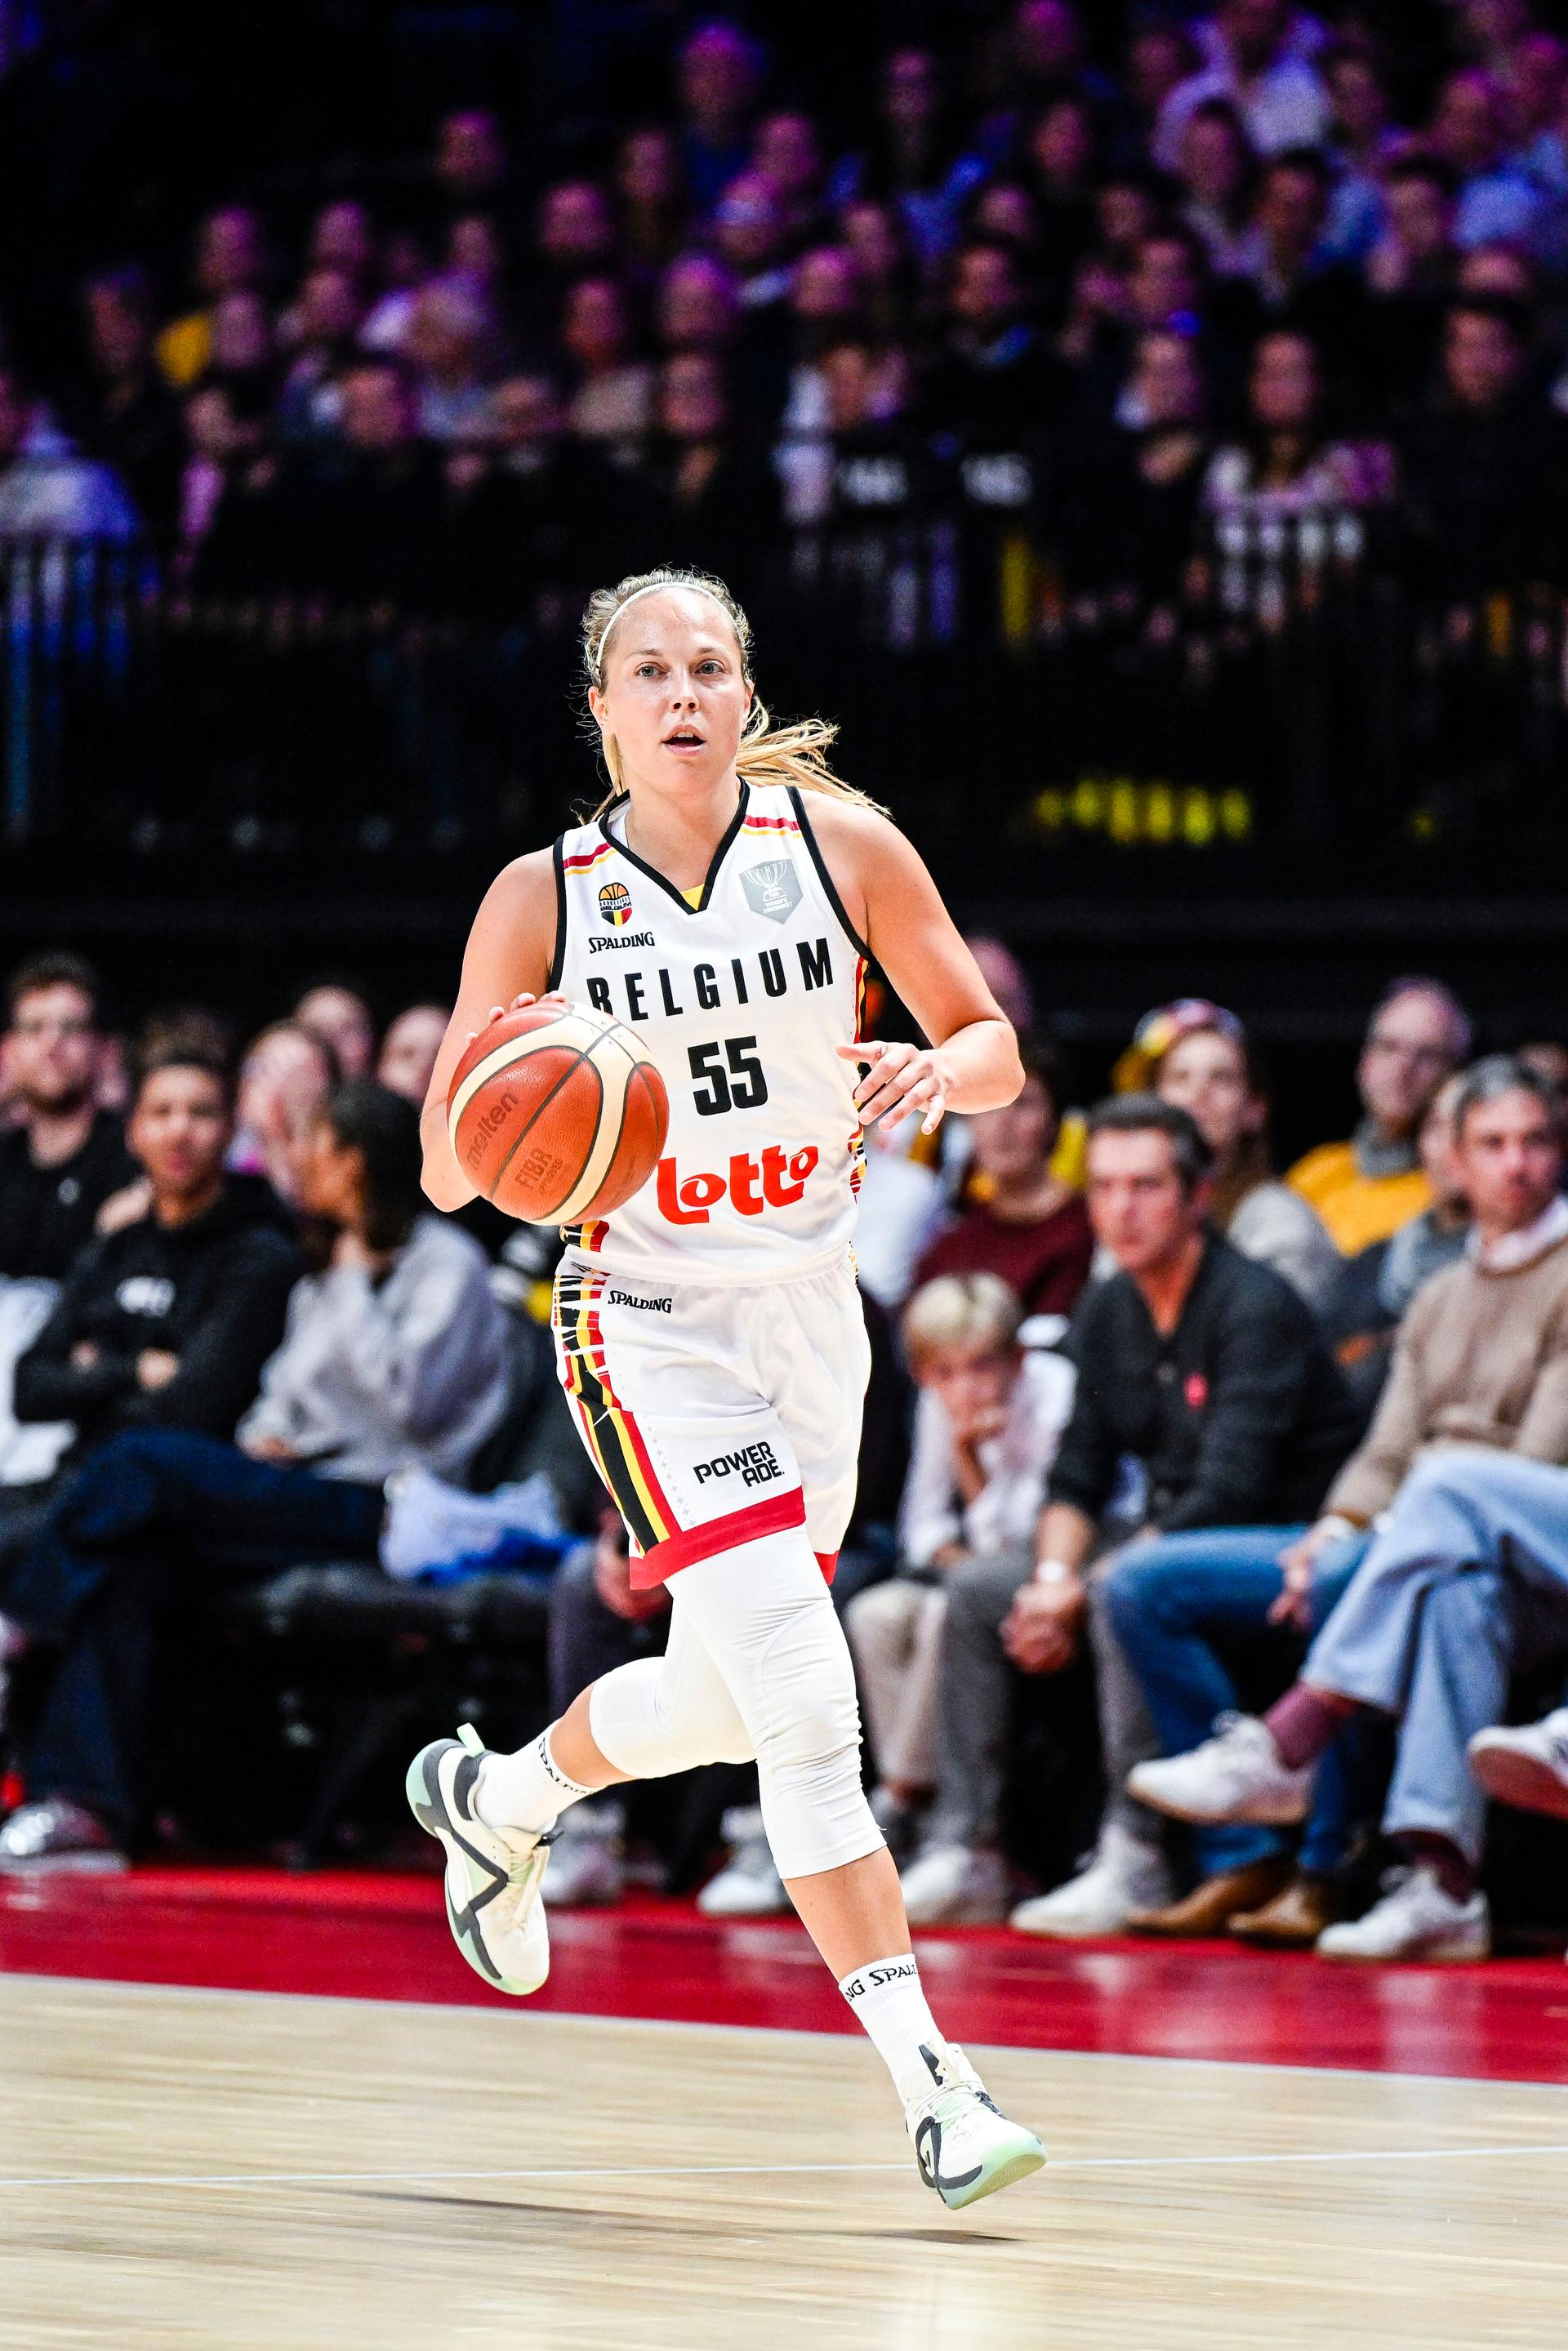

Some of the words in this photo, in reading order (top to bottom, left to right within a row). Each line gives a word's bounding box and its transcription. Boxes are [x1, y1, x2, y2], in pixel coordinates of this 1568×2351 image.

[588, 932, 656, 954] SPALDING
[586, 937, 834, 1022] BELGIUM
[688, 1035, 768, 1116] 55
[467, 1093, 519, 1171] molten
[514, 1147, 552, 1191] FIBA
[608, 1290, 673, 1314] SPALDING
[693, 1441, 774, 1485] POWER
[868, 1964, 917, 1987] SPAL
